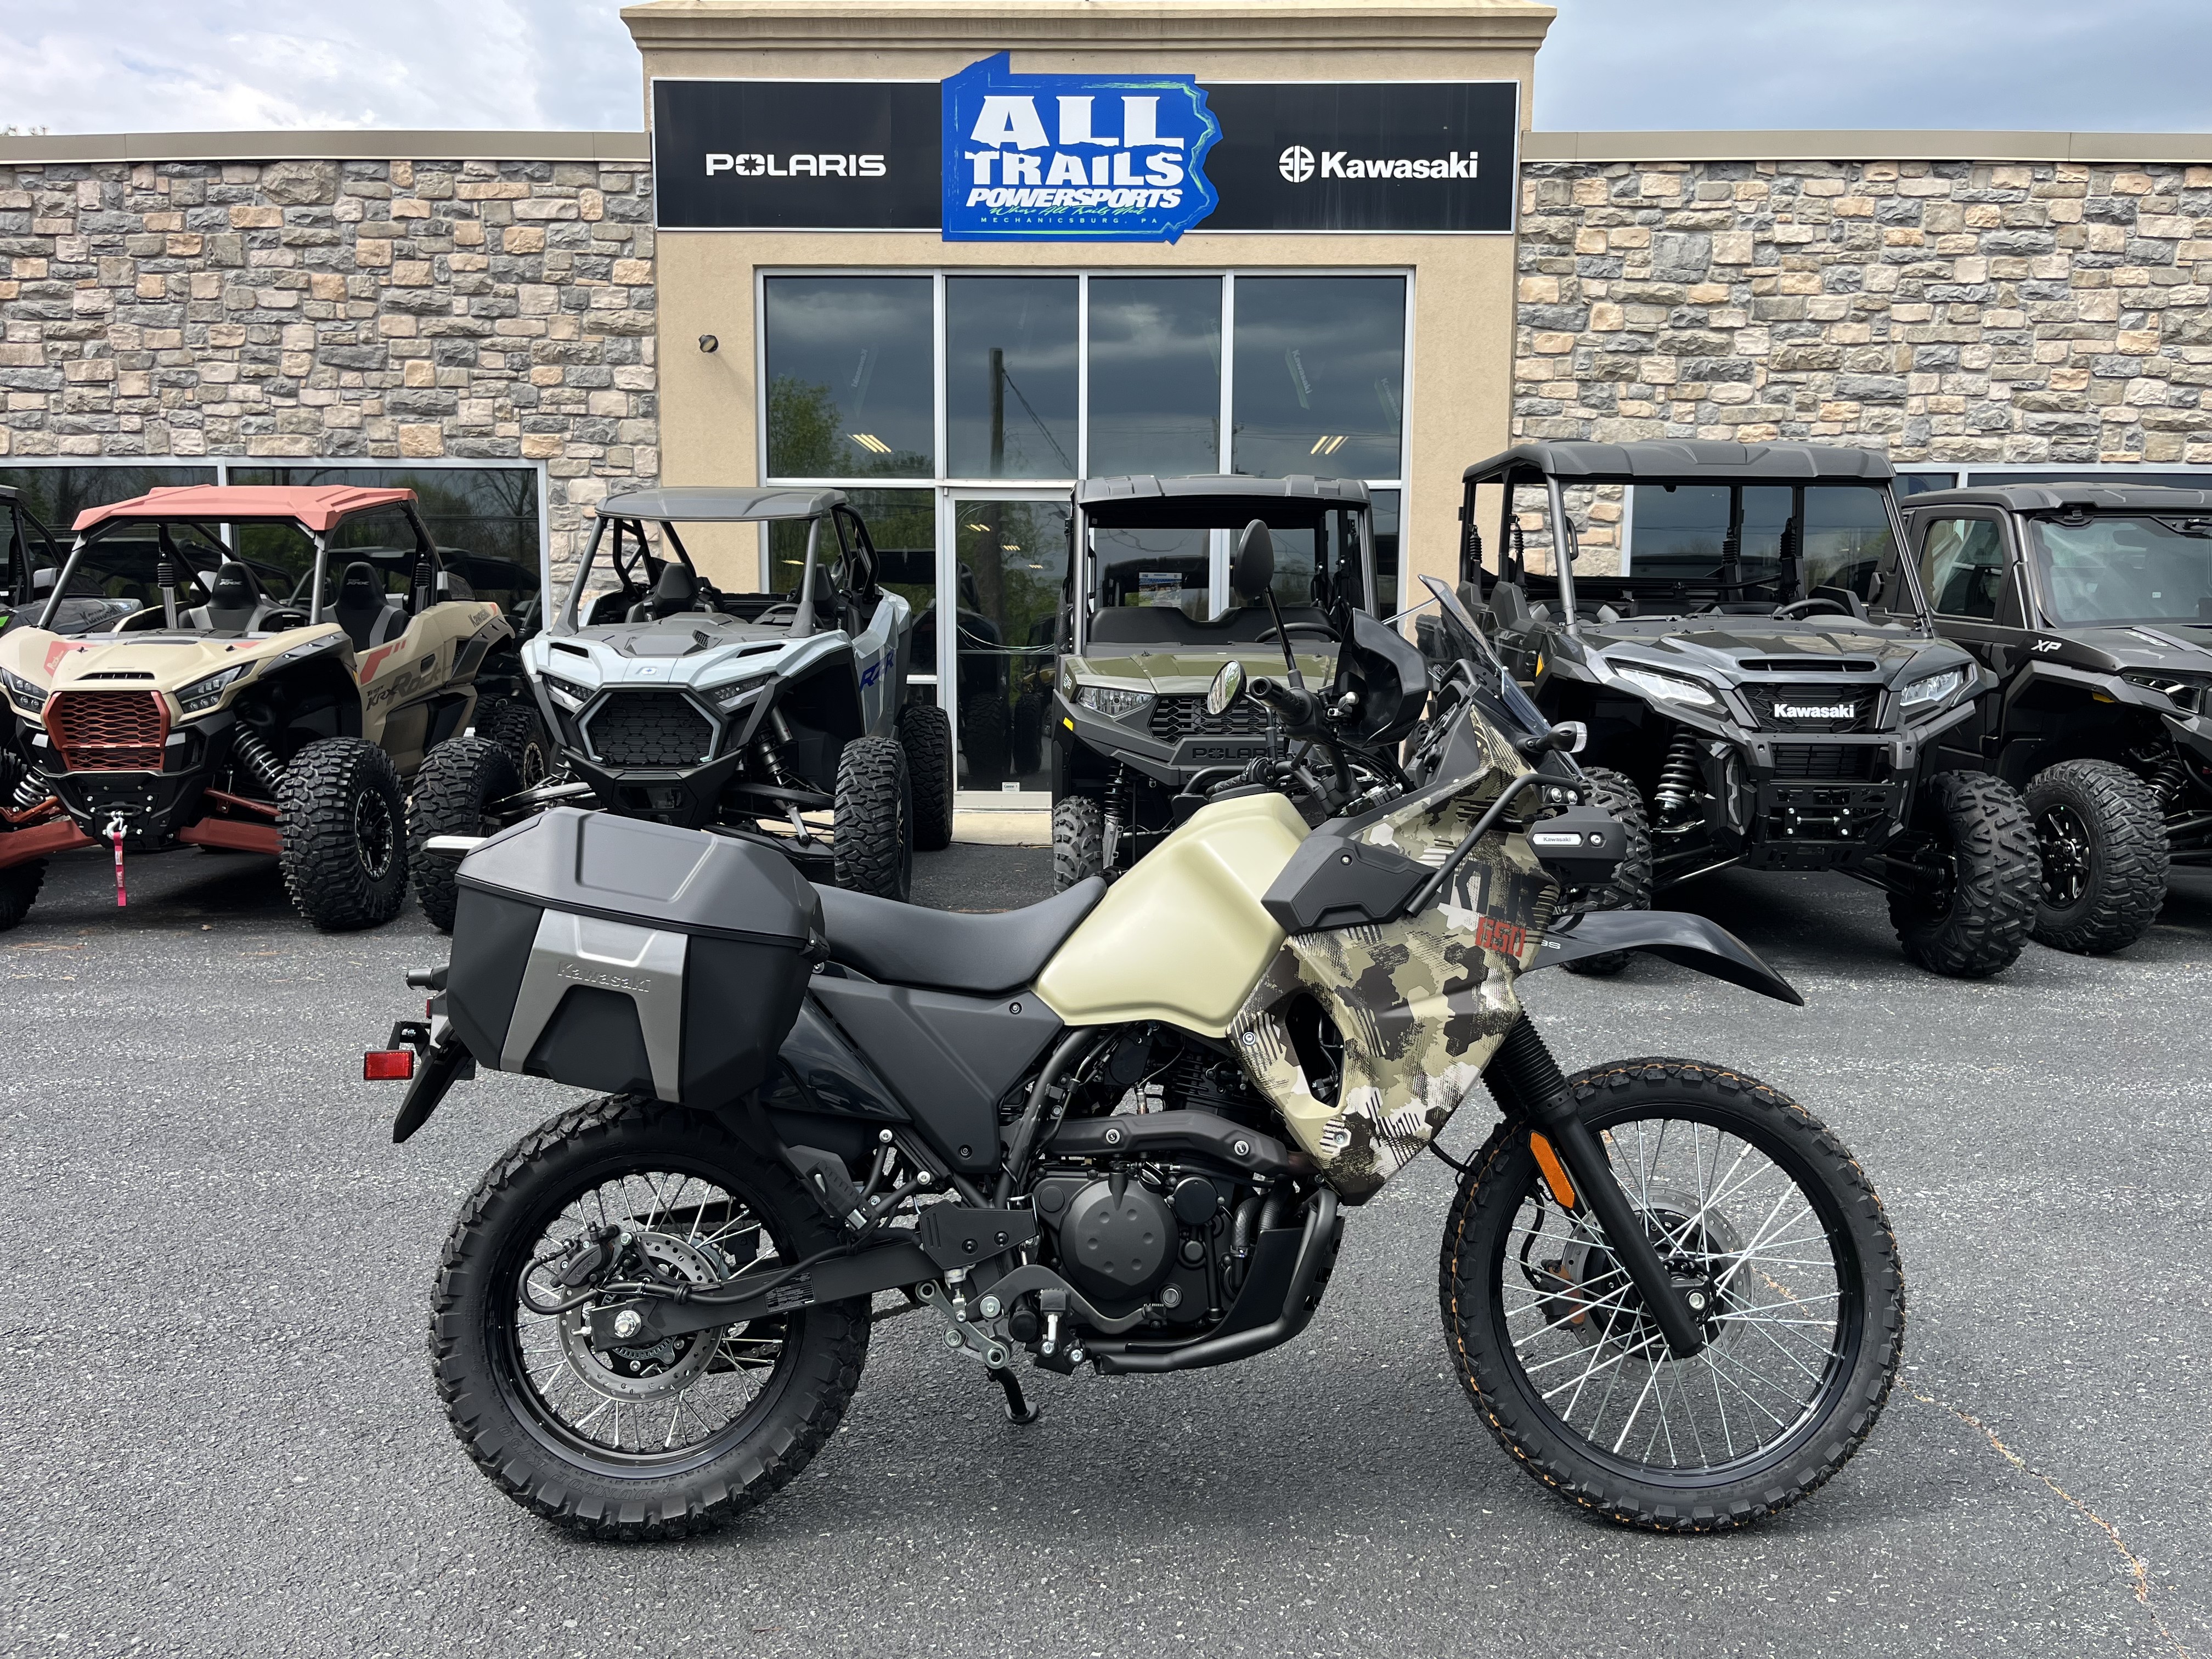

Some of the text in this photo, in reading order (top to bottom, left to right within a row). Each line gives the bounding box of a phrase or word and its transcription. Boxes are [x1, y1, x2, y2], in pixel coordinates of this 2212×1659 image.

[970, 95, 1184, 151] ALL
[706, 154, 887, 177] POLARIS
[964, 150, 1184, 187] TRAILS
[1321, 151, 1479, 179] Kawasaki
[966, 188, 1183, 209] POWERSPORTS
[989, 205, 1148, 216] Where All Trails Meet
[1291, 349, 1313, 394] Kawasaki
[2030, 639, 2062, 653] XP
[860, 648, 895, 693] RZR
[1774, 703, 1855, 718] Kawasaki
[1192, 747, 1285, 760] POLAR
[1475, 916, 1527, 958] 650
[557, 961, 652, 992] Kawasaki
[497, 1426, 652, 1501] DUNLOP K750
